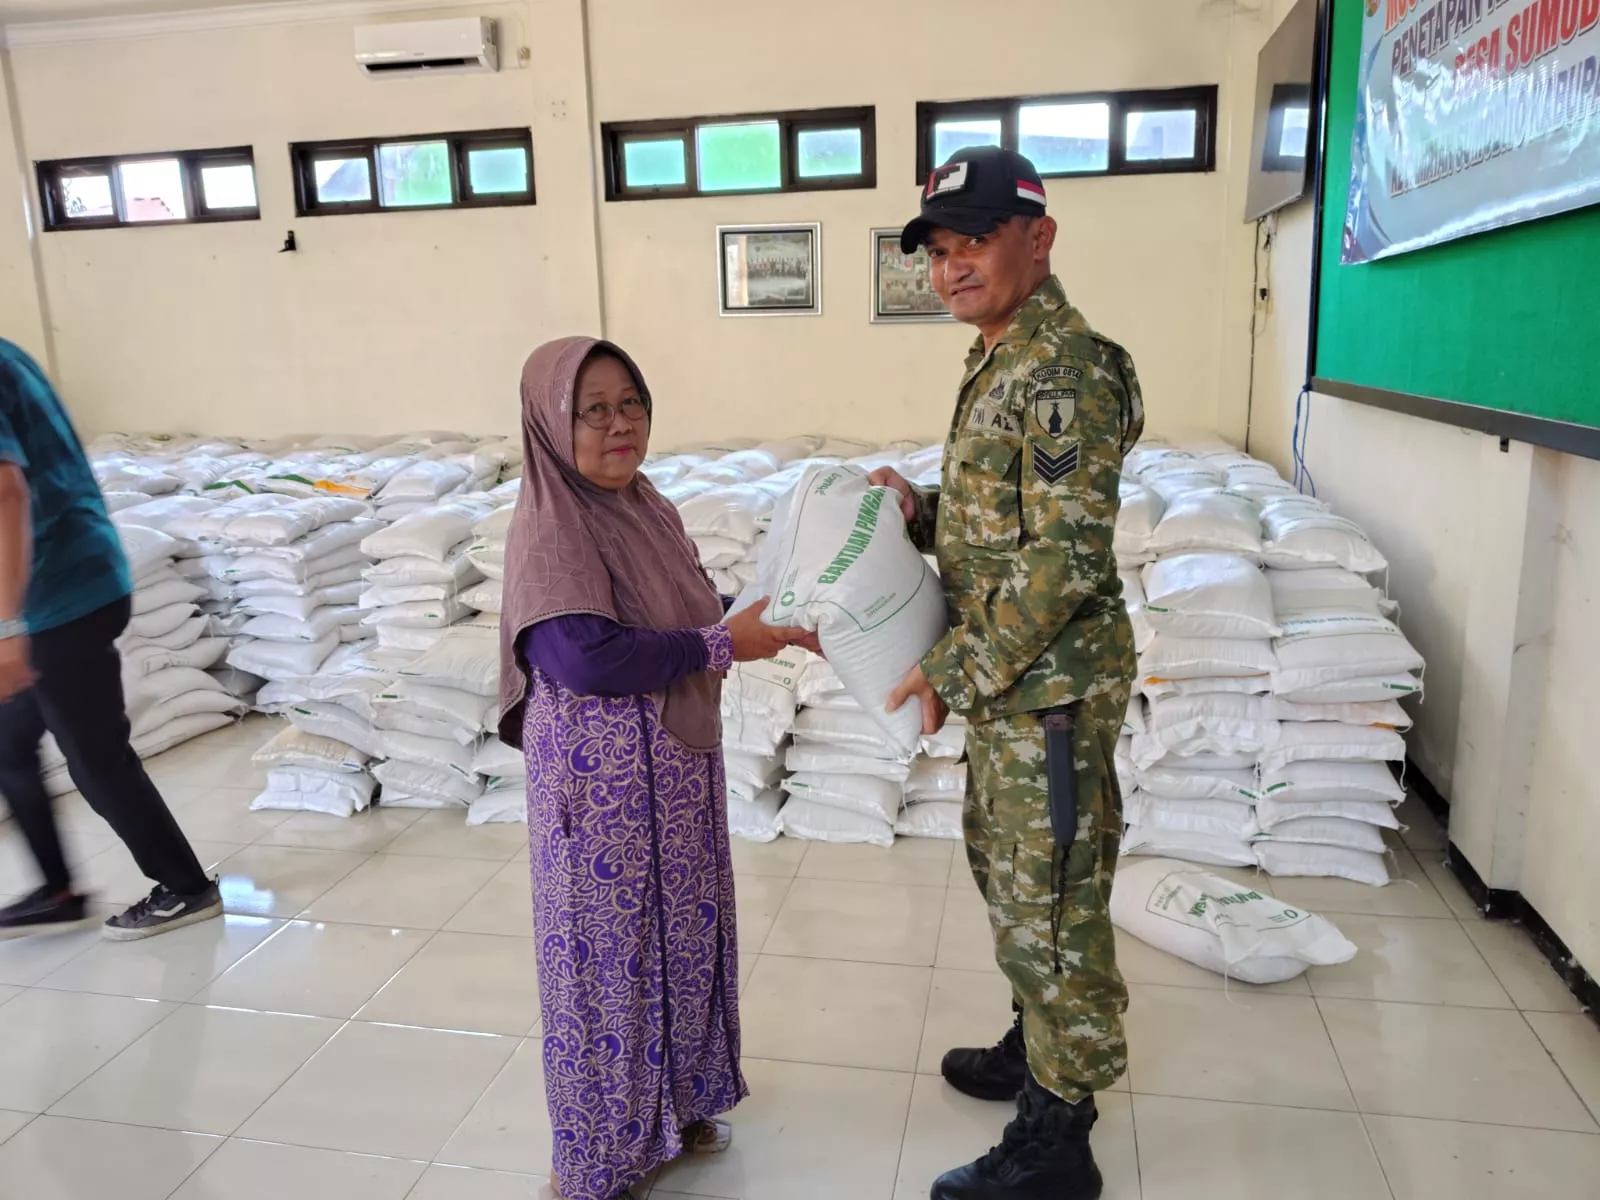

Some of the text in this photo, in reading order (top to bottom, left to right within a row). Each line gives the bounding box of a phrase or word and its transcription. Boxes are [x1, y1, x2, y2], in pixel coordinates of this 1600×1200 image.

[1391, 0, 1482, 77] PENETAPAN
[1036, 367, 1061, 379] KODIM
[817, 530, 873, 584] BANTUAN
